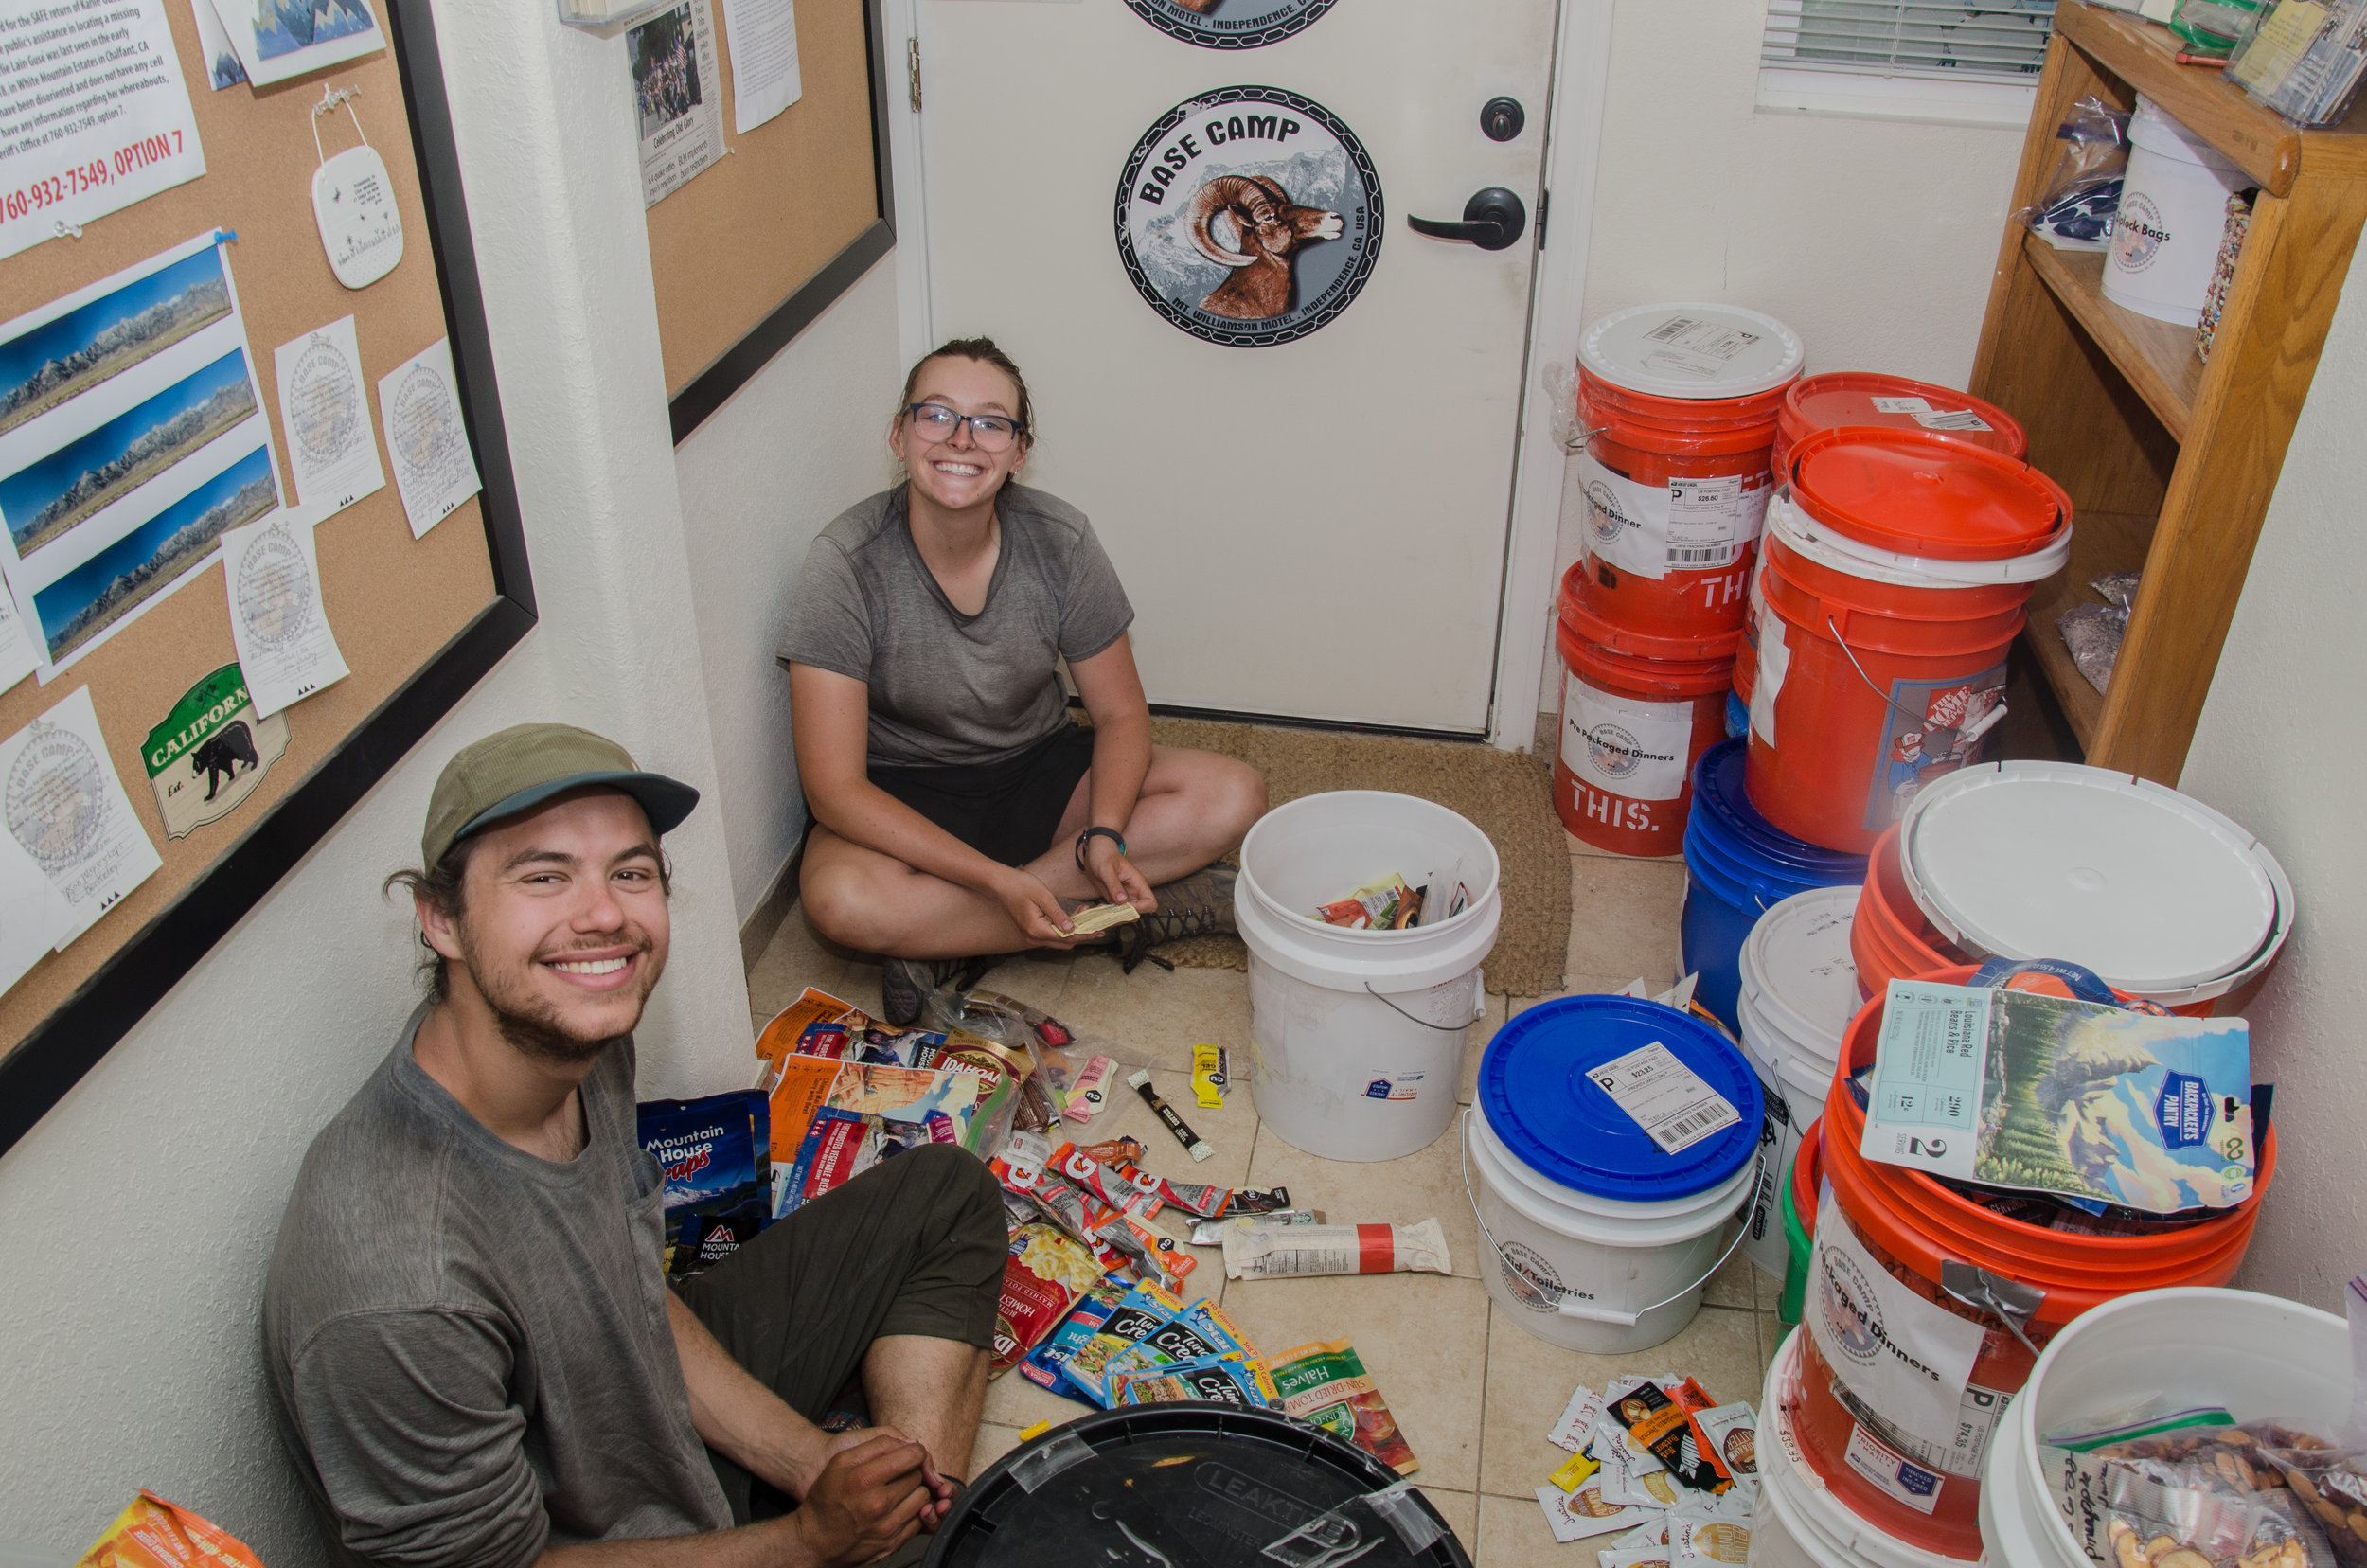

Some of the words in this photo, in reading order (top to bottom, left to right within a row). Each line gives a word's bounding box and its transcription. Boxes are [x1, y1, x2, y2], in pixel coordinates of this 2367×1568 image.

[20, 16, 31, 27] the
[31, 9, 48, 24] SAFE
[50, 5, 72, 19] return
[1166, 3, 1203, 28] MOTEL
[5, 37, 32, 55] public's
[33, 27, 68, 45] assistance
[76, 16, 104, 31] locating
[111, 8, 141, 22] missing
[10, 60, 27, 72] Lain
[46, 48, 61, 61] was
[61, 45, 74, 57] last
[75, 41, 90, 52] seen
[98, 32, 110, 45] the
[111, 27, 130, 40] early
[16, 76, 40, 91] White
[39, 63, 74, 83] Mountain
[72, 57, 98, 72] Estates
[105, 44, 138, 62] Chalfant,
[138, 40, 150, 52] CA
[17, 97, 36, 112] been
[36, 83, 75, 105] disoriented
[75, 79, 88, 92] and
[89, 74, 105, 87] does
[105, 70, 117, 82] not
[117, 64, 133, 79] have
[134, 61, 149, 75] any
[150, 55, 164, 68] cell
[1, 124, 19, 138] have
[20, 120, 34, 134] any
[33, 105, 75, 127] information
[75, 93, 109, 114] regarding
[107, 89, 119, 100] her
[118, 74, 169, 97] whereabouts,
[20, 137, 41, 152] Office
[98, 107, 119, 125] option
[114, 133, 172, 177] OPTION
[171, 130, 183, 154] 7
[1139, 134, 1203, 205] BASE
[1205, 115, 1301, 147] CAMP
[2141, 223, 2172, 243] Bags
[1171, 296, 1190, 317] MT.
[1192, 309, 1259, 332] WILLIAMSON
[1260, 313, 1295, 331] MOTEL
[1355, 205, 1366, 231] USA
[1671, 488, 1682, 502] P
[1608, 508, 1642, 530] Dinner
[1923, 685, 1972, 733] HOME
[1931, 691, 1954, 711] THE
[1569, 718, 1581, 733] Pre
[1582, 729, 1629, 757] Packaged
[1631, 748, 1675, 761] Dinners
[166, 779, 185, 798] Est.
[1571, 778, 1660, 832] THIS.
[2054, 966, 2068, 976] WT
[2068, 971, 2083, 982] NET
[1948, 1009, 1963, 1030] Beans
[1961, 1010, 1977, 1044] Louisiana
[1946, 1038, 1960, 1054] Rice
[1960, 1044, 1973, 1058] Red
[1210, 1074, 1225, 1084] GU
[1631, 1064, 1655, 1078] $23.25
[1086, 1091, 1101, 1102] GU
[1599, 1077, 1615, 1093] P
[1947, 1096, 1963, 1117] 290
[2162, 1094, 2180, 1128] PANTRY
[2183, 1081, 2200, 1141] BACKPACKER'S
[646, 1126, 724, 1152] Mountain
[832, 1132, 848, 1149] ROASTED
[842, 1123, 852, 1133] FIRE
[660, 1142, 713, 1164] House
[1908, 1136, 1948, 1159] 2
[823, 1149, 840, 1177] VEGETABLE
[1158, 1238, 1174, 1251] GU
[1023, 1288, 1054, 1310] MASHED
[1147, 1280, 1156, 1291] 80
[1155, 1286, 1179, 1307] Calories
[1851, 1278, 1875, 1312] CAMP
[1207, 1300, 1219, 1312] 110
[1214, 1311, 1237, 1332] Calories
[1869, 1320, 1941, 1382] Dinners
[1256, 1362, 1264, 1371] 80
[1282, 1366, 1330, 1391] Halves
[1258, 1370, 1273, 1396] Calories
[1314, 1379, 1366, 1400] SUN-DRIED
[1966, 1388, 1995, 1408] P
[1652, 1433, 1680, 1452] Butter
[1954, 1421, 1974, 1449] $74.35
[1611, 1433, 1636, 1463] Justin's
[1658, 1444, 1676, 1458] Nut
[1855, 1432, 1899, 1466] PRIORITY
[1863, 1447, 1885, 1463] MAIL
[1901, 1475, 1929, 1492] INSURED
[1904, 1466, 1932, 1484] TRACKED
[1555, 1494, 1575, 1525] Justin's
[1682, 1522, 1695, 1559] Justin's
[1718, 1525, 1735, 1564] PEANUT
[1734, 1525, 1749, 1564] BUTTER
